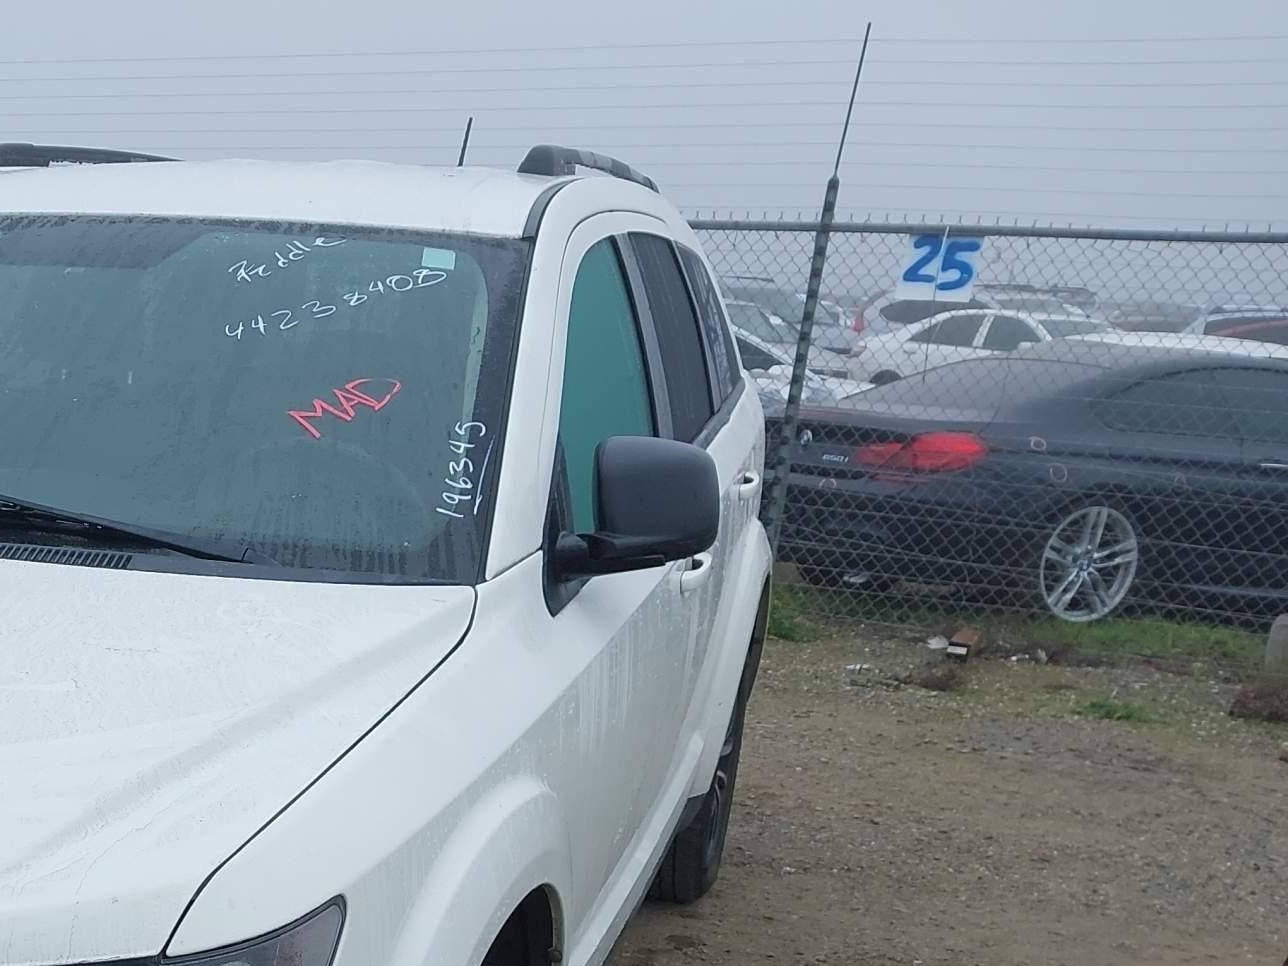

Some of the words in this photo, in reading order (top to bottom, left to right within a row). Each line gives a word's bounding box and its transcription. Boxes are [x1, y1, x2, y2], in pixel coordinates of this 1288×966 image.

[902, 233, 981, 291] 25
[287, 377, 402, 440] MAD
[435, 420, 487, 518] 196345
